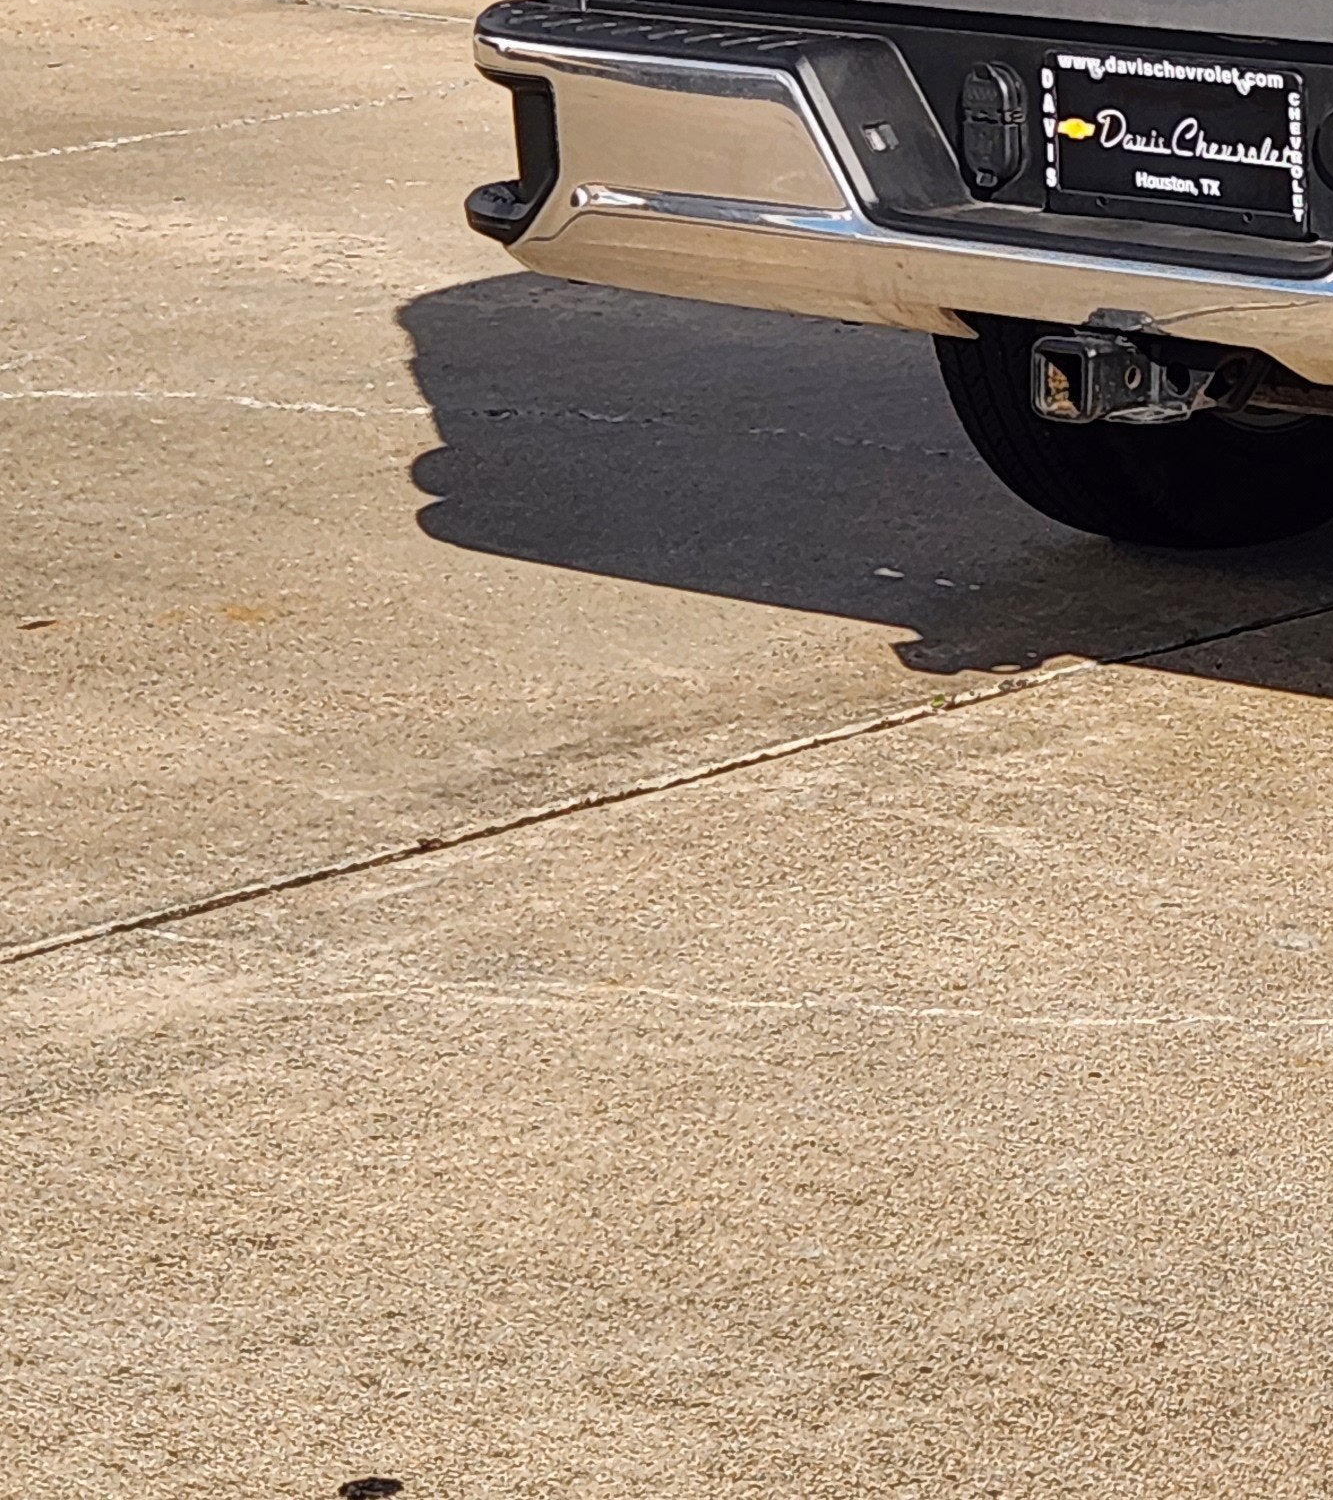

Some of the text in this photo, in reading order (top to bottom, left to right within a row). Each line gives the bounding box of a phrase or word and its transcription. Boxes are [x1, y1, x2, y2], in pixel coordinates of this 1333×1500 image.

[1056, 54, 1285, 93] www.davischevrolet.com
[1041, 67, 1057, 188] DAVIS
[1096, 108, 1172, 155] Davis
[1287, 92, 1304, 223] CHEVROLET
[1135, 170, 1222, 197] Houston, TX
